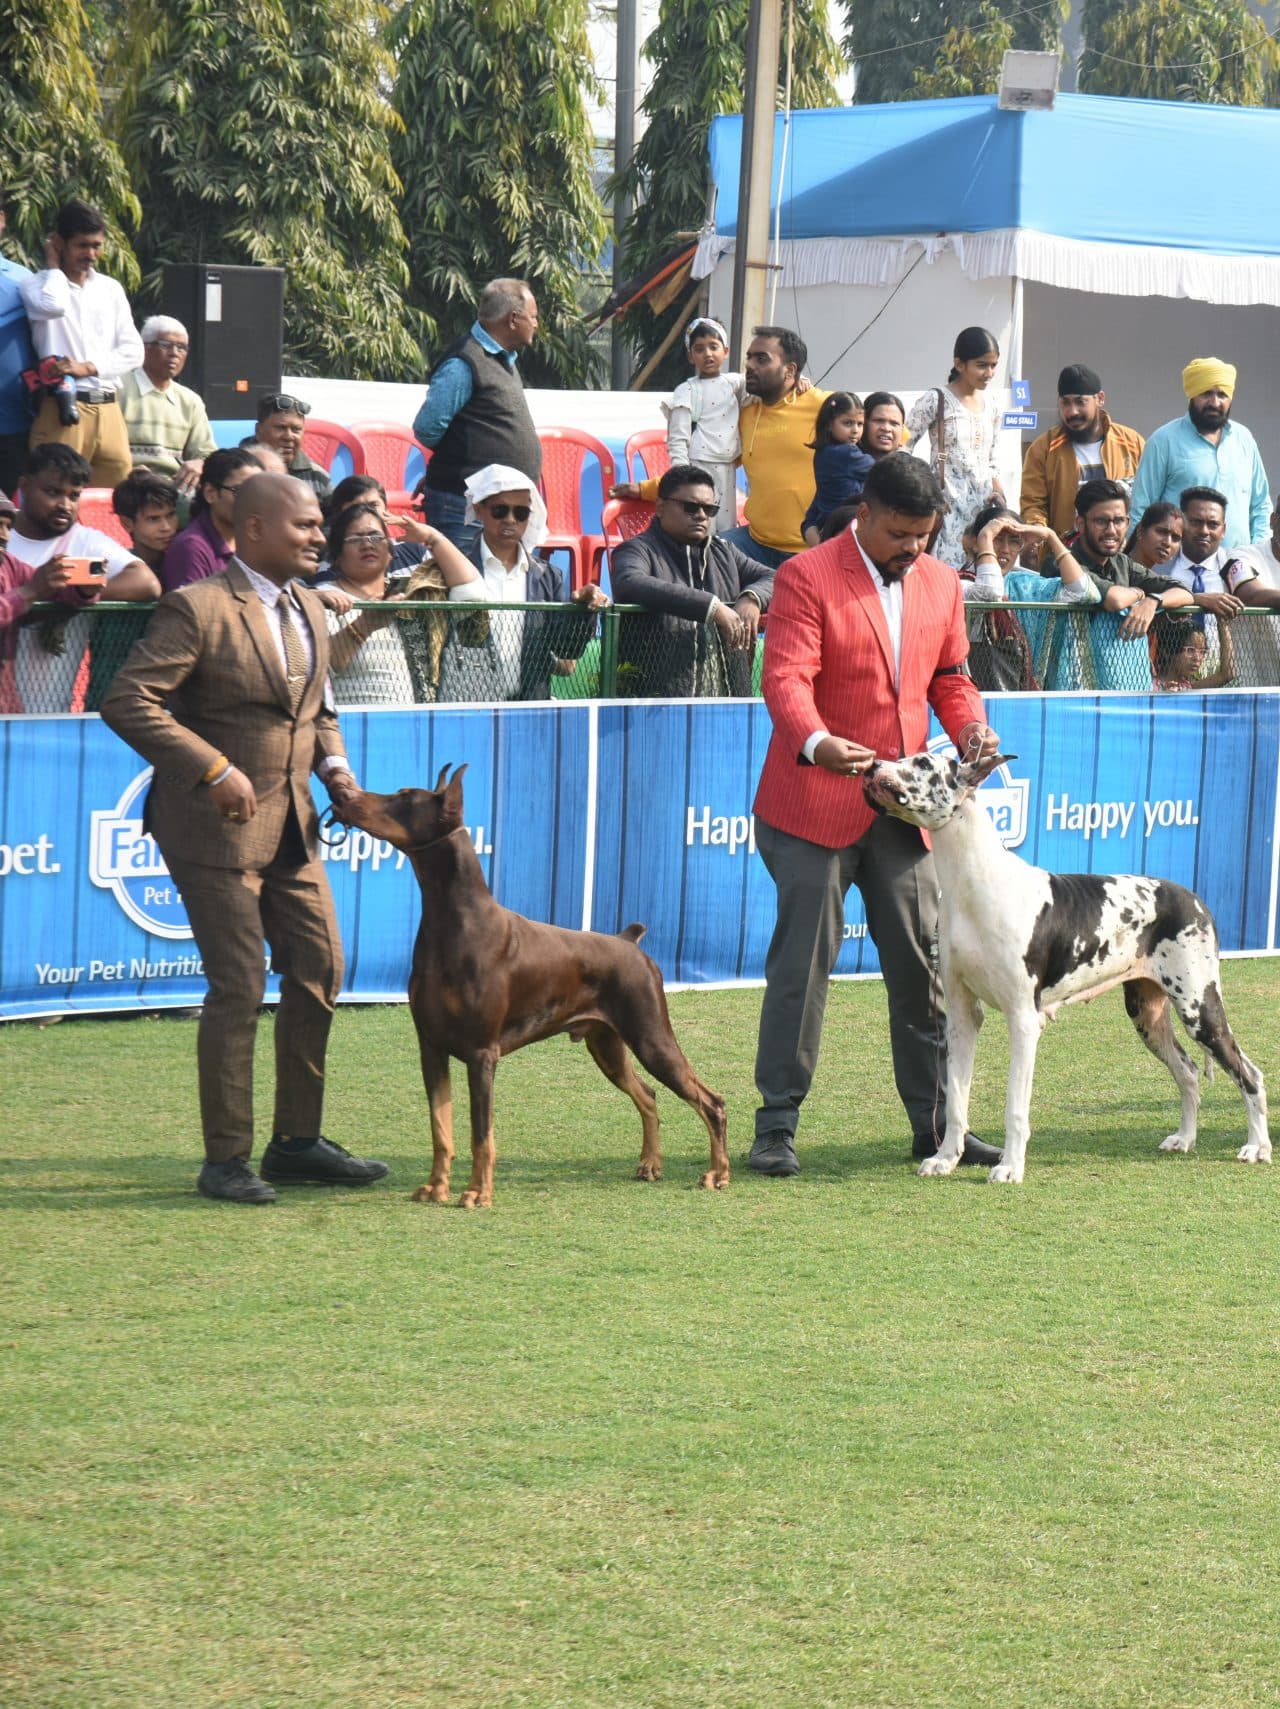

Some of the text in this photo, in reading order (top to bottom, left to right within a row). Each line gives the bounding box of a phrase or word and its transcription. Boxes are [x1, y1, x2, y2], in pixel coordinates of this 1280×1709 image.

[1015, 386, 1027, 400] S1
[1046, 793, 1136, 840] Happy
[1144, 798, 1199, 838] you.
[143, 886, 172, 905] Pet
[35, 963, 85, 985] Your
[88, 960, 126, 981] Pet
